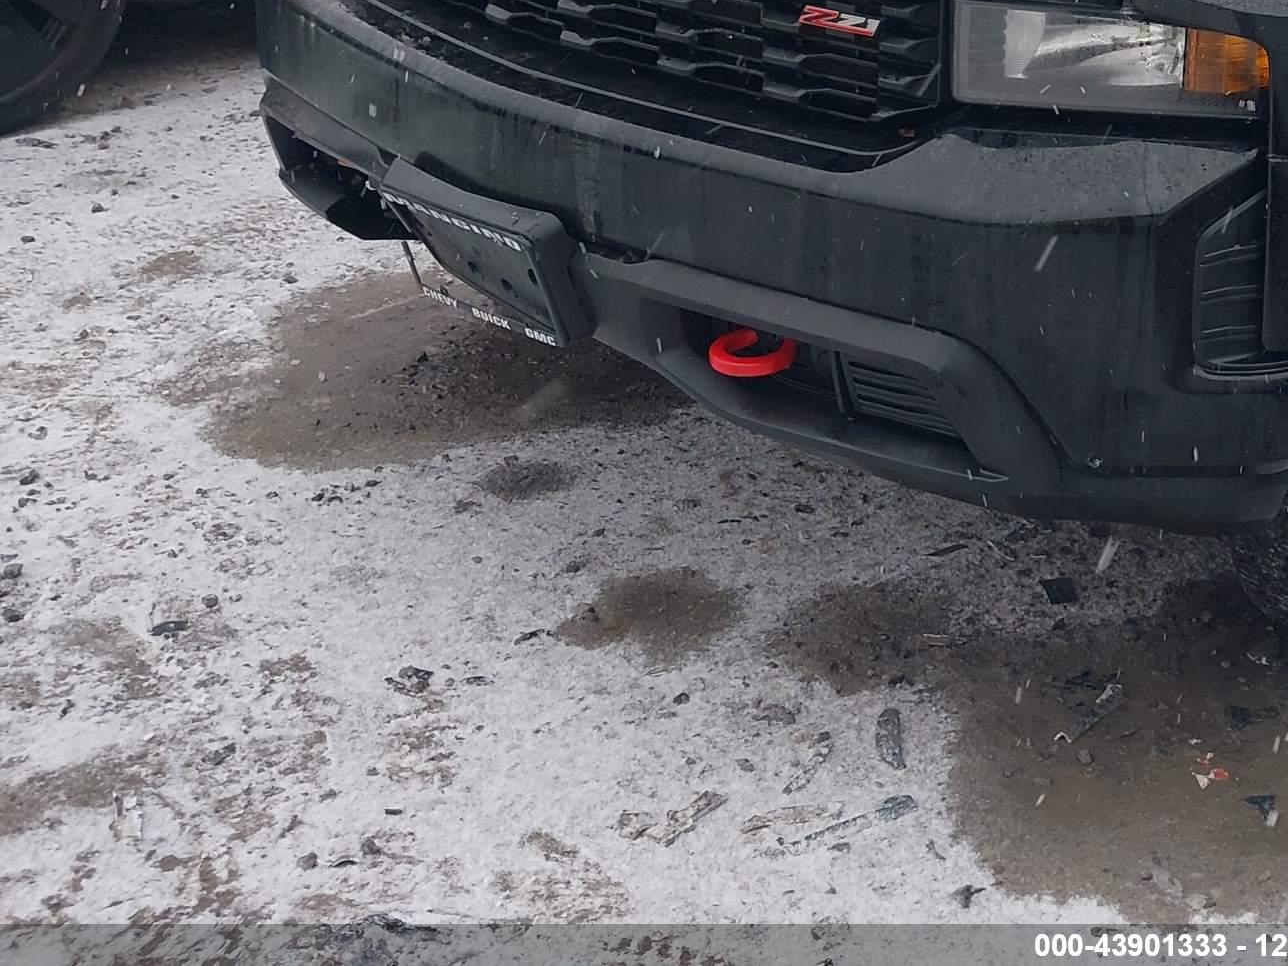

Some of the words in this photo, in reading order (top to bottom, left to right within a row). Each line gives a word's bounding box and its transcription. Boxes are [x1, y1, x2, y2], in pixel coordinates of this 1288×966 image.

[798, 4, 881, 37] Z71
[422, 286, 458, 310] CHEVY
[471, 306, 512, 330] BUICK
[523, 326, 557, 347] GMC
